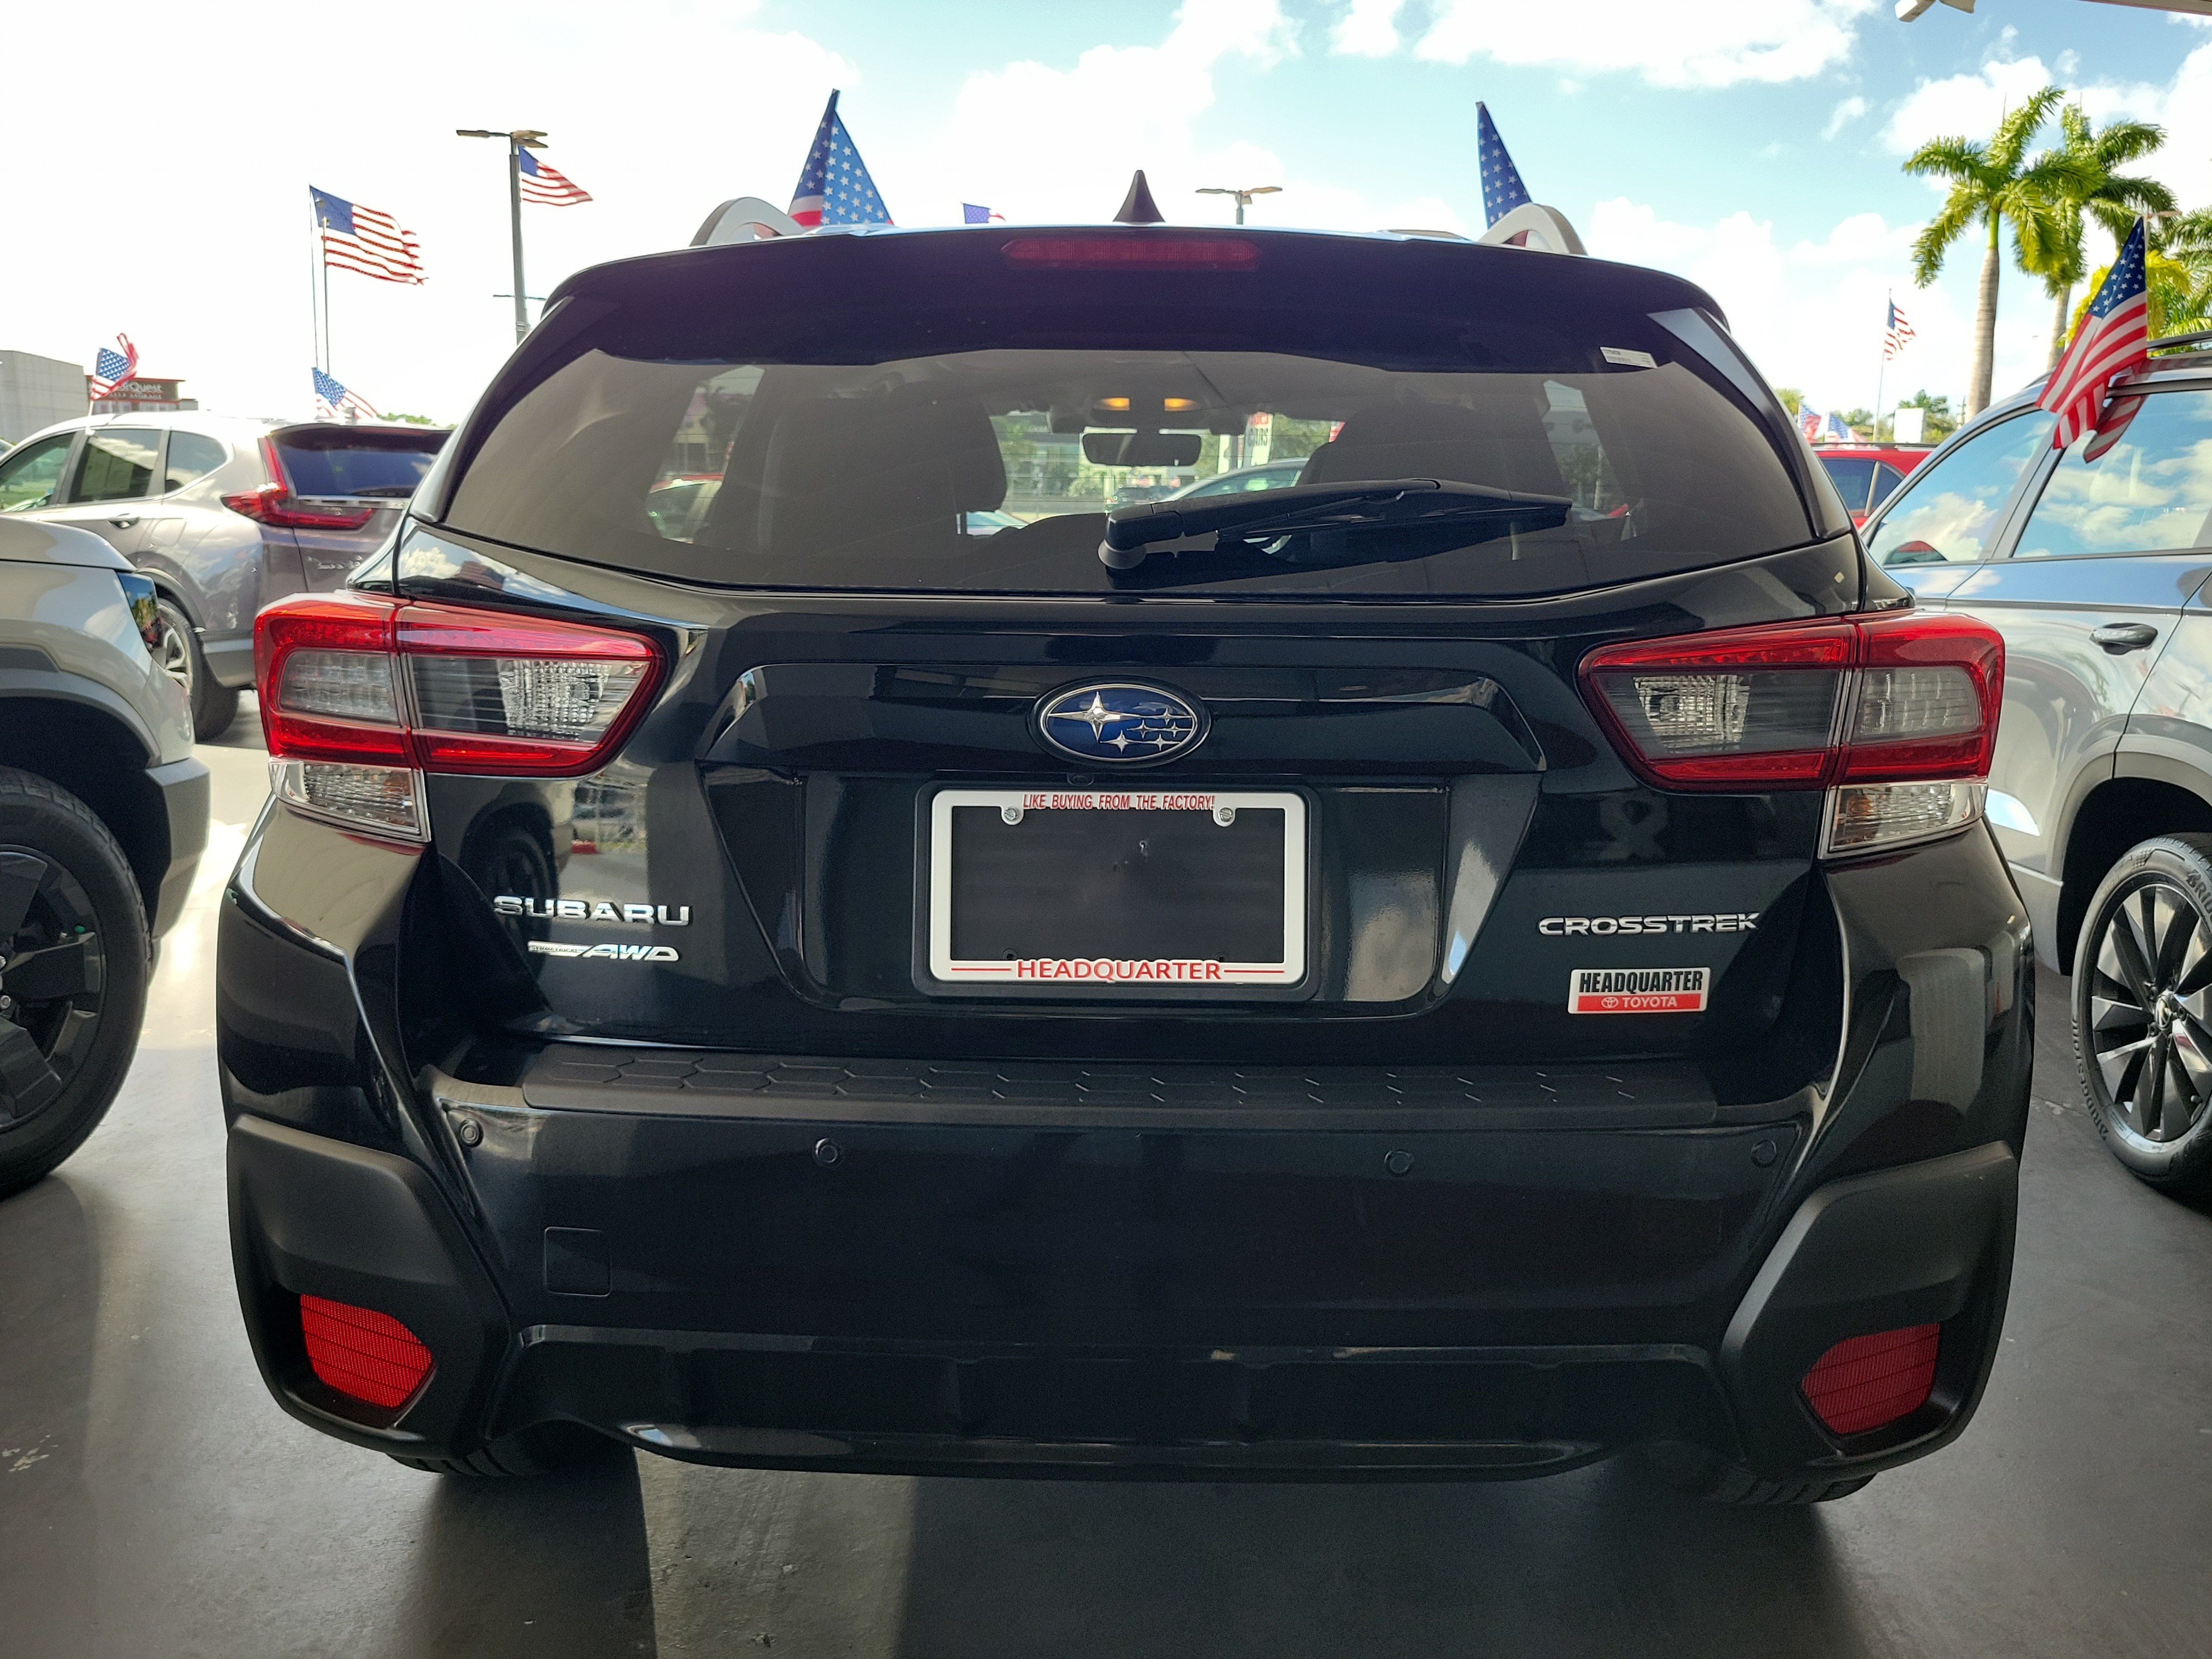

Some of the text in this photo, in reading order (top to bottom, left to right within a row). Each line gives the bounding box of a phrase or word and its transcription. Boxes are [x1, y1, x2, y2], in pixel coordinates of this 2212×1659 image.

[1023, 794, 1215, 810] LIKE BUYING FROM THE FACTORY!
[494, 895, 690, 926] SUBARU
[1538, 912, 1760, 936] CROSSTREK
[582, 943, 679, 962] AWD
[1017, 960, 1222, 980] HEADQUARTER
[1578, 970, 1703, 994] HEADQUARTER
[1622, 996, 1678, 1008] TOYOTA
